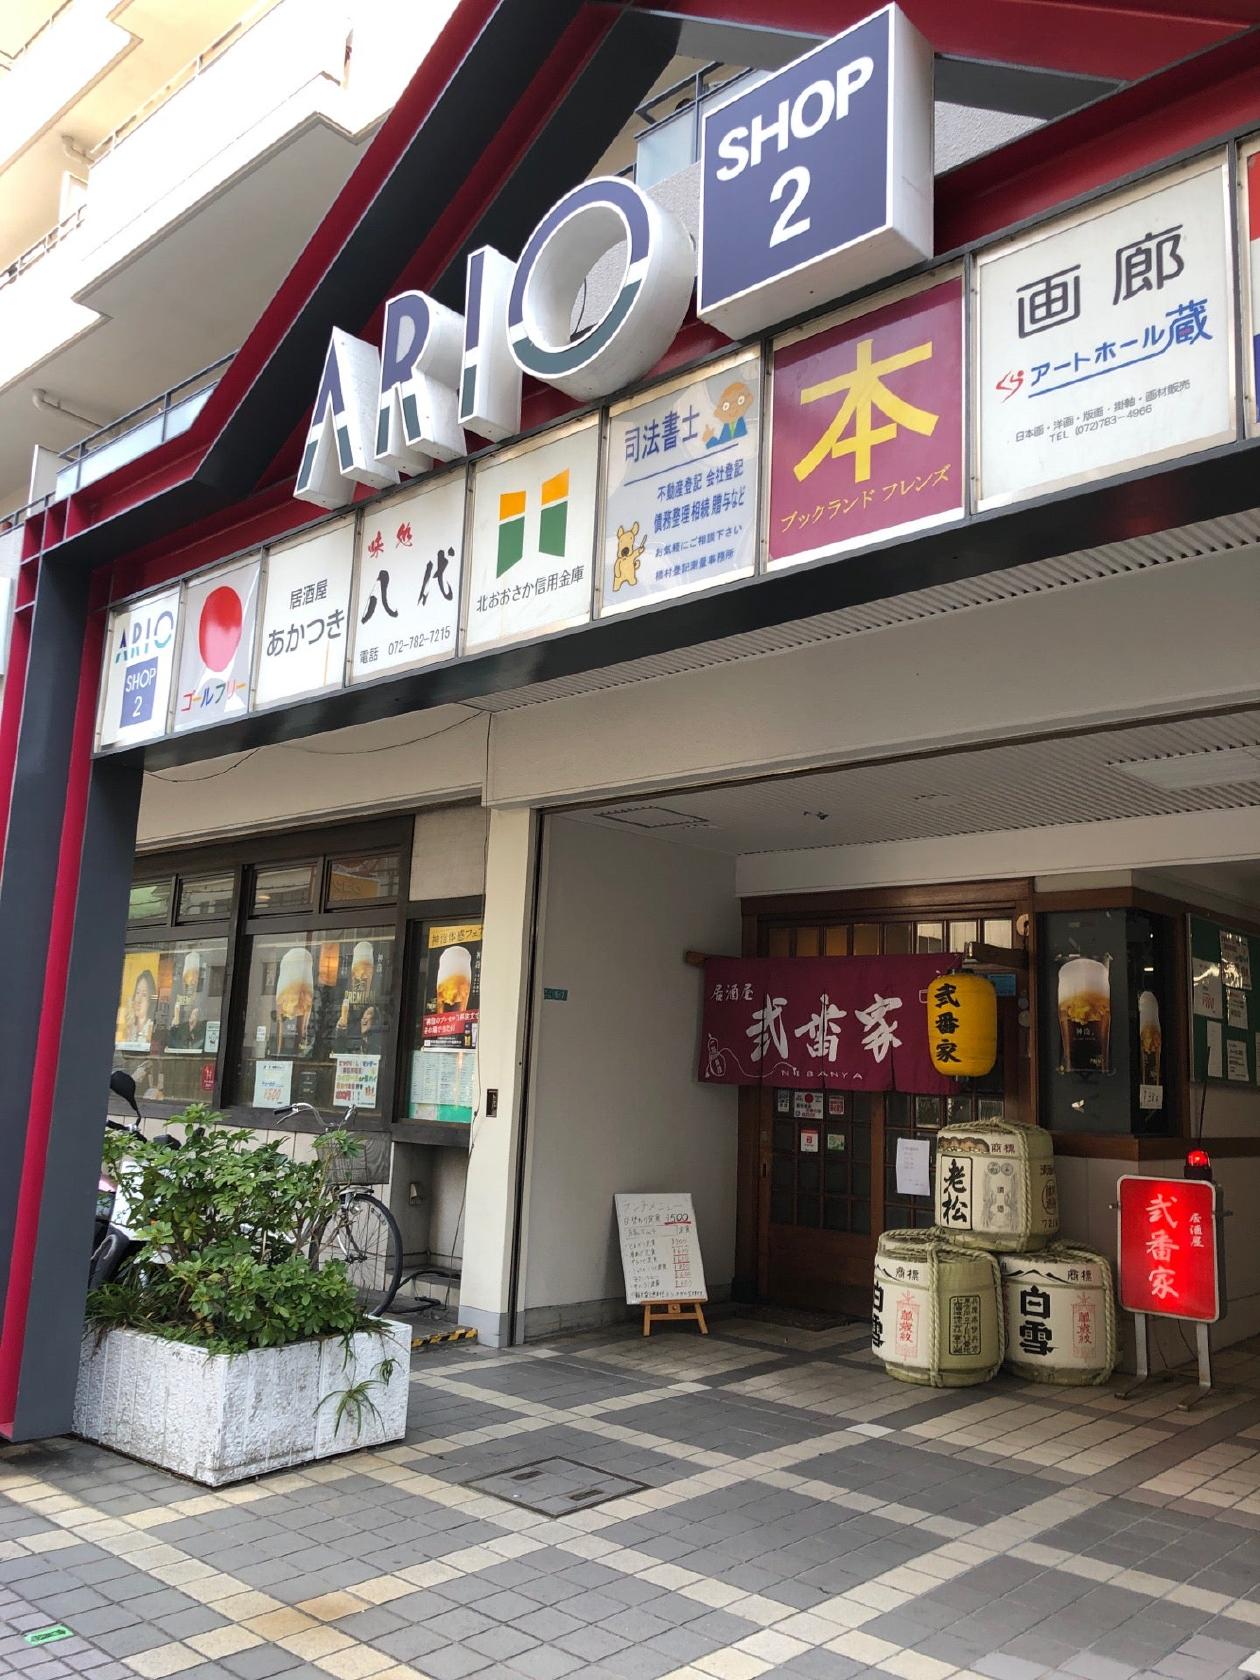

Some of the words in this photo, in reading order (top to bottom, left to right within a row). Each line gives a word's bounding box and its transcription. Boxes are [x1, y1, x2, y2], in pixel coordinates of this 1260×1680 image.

[715, 56, 875, 183] SHOP
[768, 166, 812, 248] 2
[1016, 224, 1186, 340] 画廊
[294, 176, 662, 502] ARIO
[1028, 298, 1214, 387] アートホール蔵
[624, 404, 701, 463] 司法書士
[793, 339, 940, 484] 本
[1048, 429, 1070, 444] TEL
[656, 473, 703, 503] 不動産登記
[705, 458, 745, 488] 会社登記
[781, 489, 875, 533] ブックランド
[882, 464, 952, 502] フレンズ
[368, 523, 414, 558] 味処
[289, 578, 329, 611] 居酒屋
[360, 546, 454, 624] 八代
[476, 565, 585, 613] 北おおさか信用金庫
[115, 610, 175, 665] ARIO
[267, 608, 346, 657] あかつき
[359, 646, 379, 665] 電話
[388, 625, 452, 657] 072-782-7215
[125, 667, 157, 692] SHOP
[131, 696, 144, 718] 2
[181, 680, 247, 713] ゴールフリー
[711, 984, 754, 1001] 居酒屋
[942, 1158, 968, 1225] 老松
[1019, 1285, 1055, 1357] 白雪
